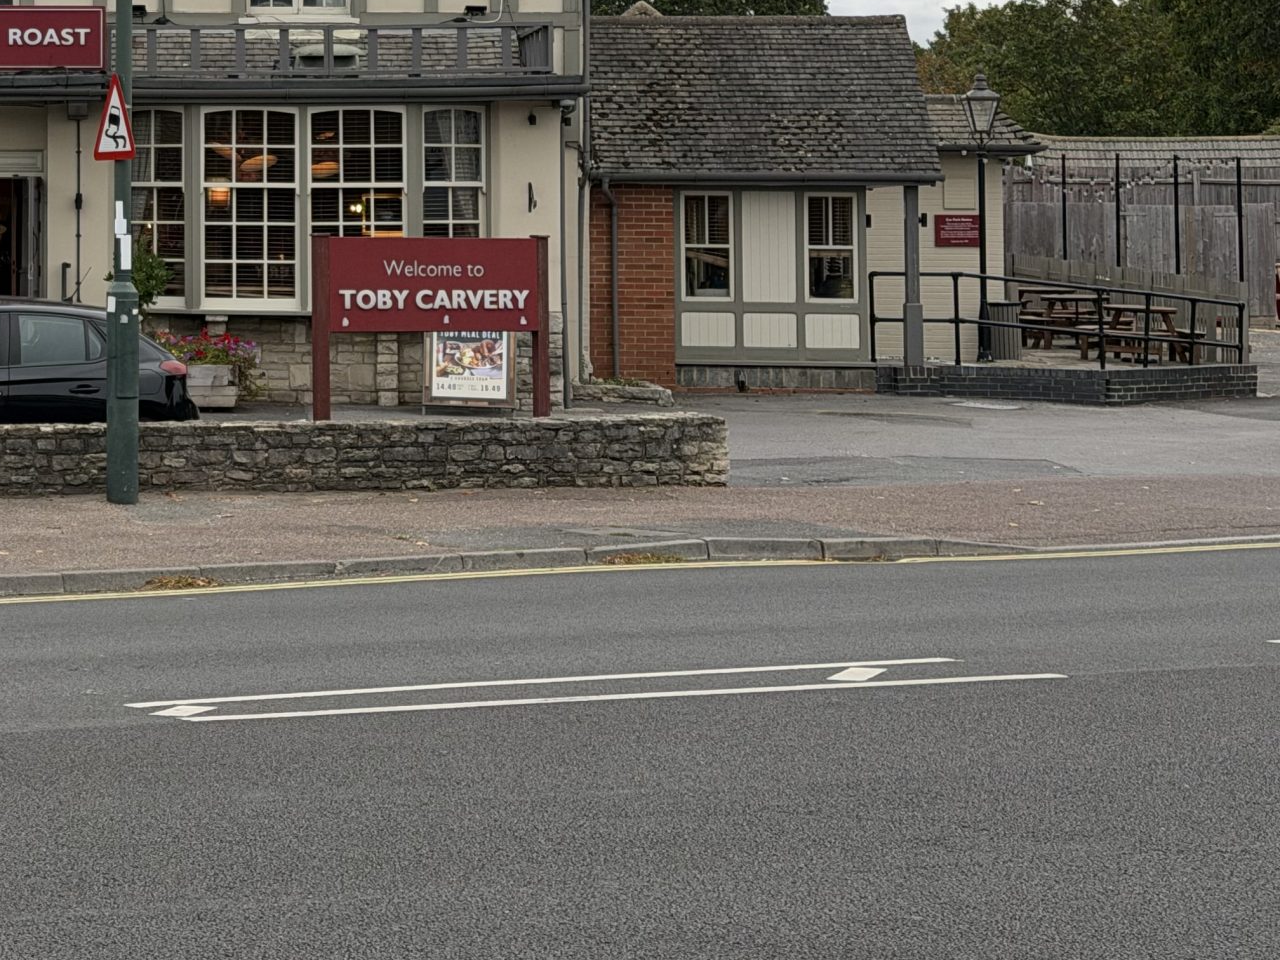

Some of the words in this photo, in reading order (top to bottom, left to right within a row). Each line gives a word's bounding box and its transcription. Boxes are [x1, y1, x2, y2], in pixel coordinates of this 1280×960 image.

[8, 28, 91, 46] ROAST
[383, 259, 462, 277] Welcome
[467, 263, 485, 277] to
[338, 289, 409, 310] TOBY
[415, 289, 530, 310] CARVERY
[482, 331, 500, 339] DEAL
